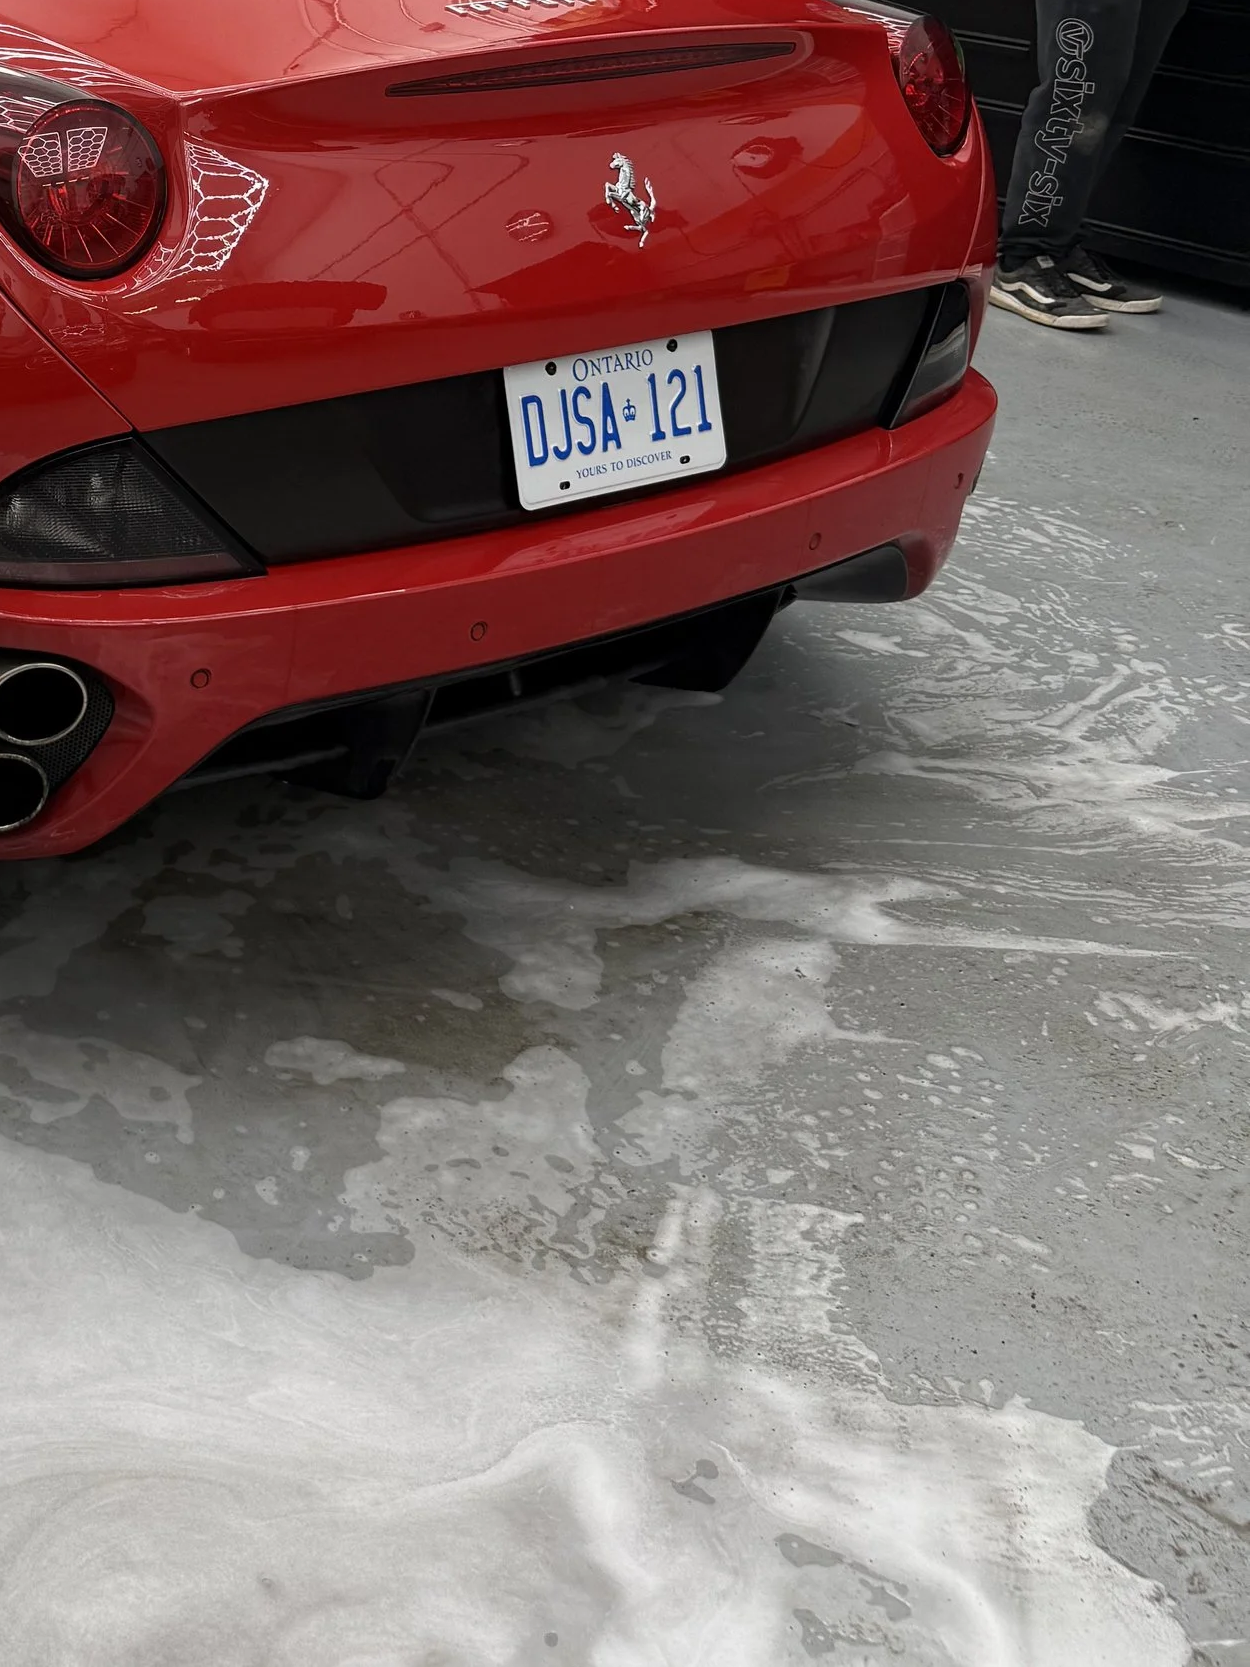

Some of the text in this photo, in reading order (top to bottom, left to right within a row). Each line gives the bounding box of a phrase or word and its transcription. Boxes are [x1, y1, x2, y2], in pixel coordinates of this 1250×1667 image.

[572, 349, 653, 382] ONTARIO
[520, 365, 712, 467] DJSA 121
[576, 450, 672, 479] YOURS TO DISCOVER
